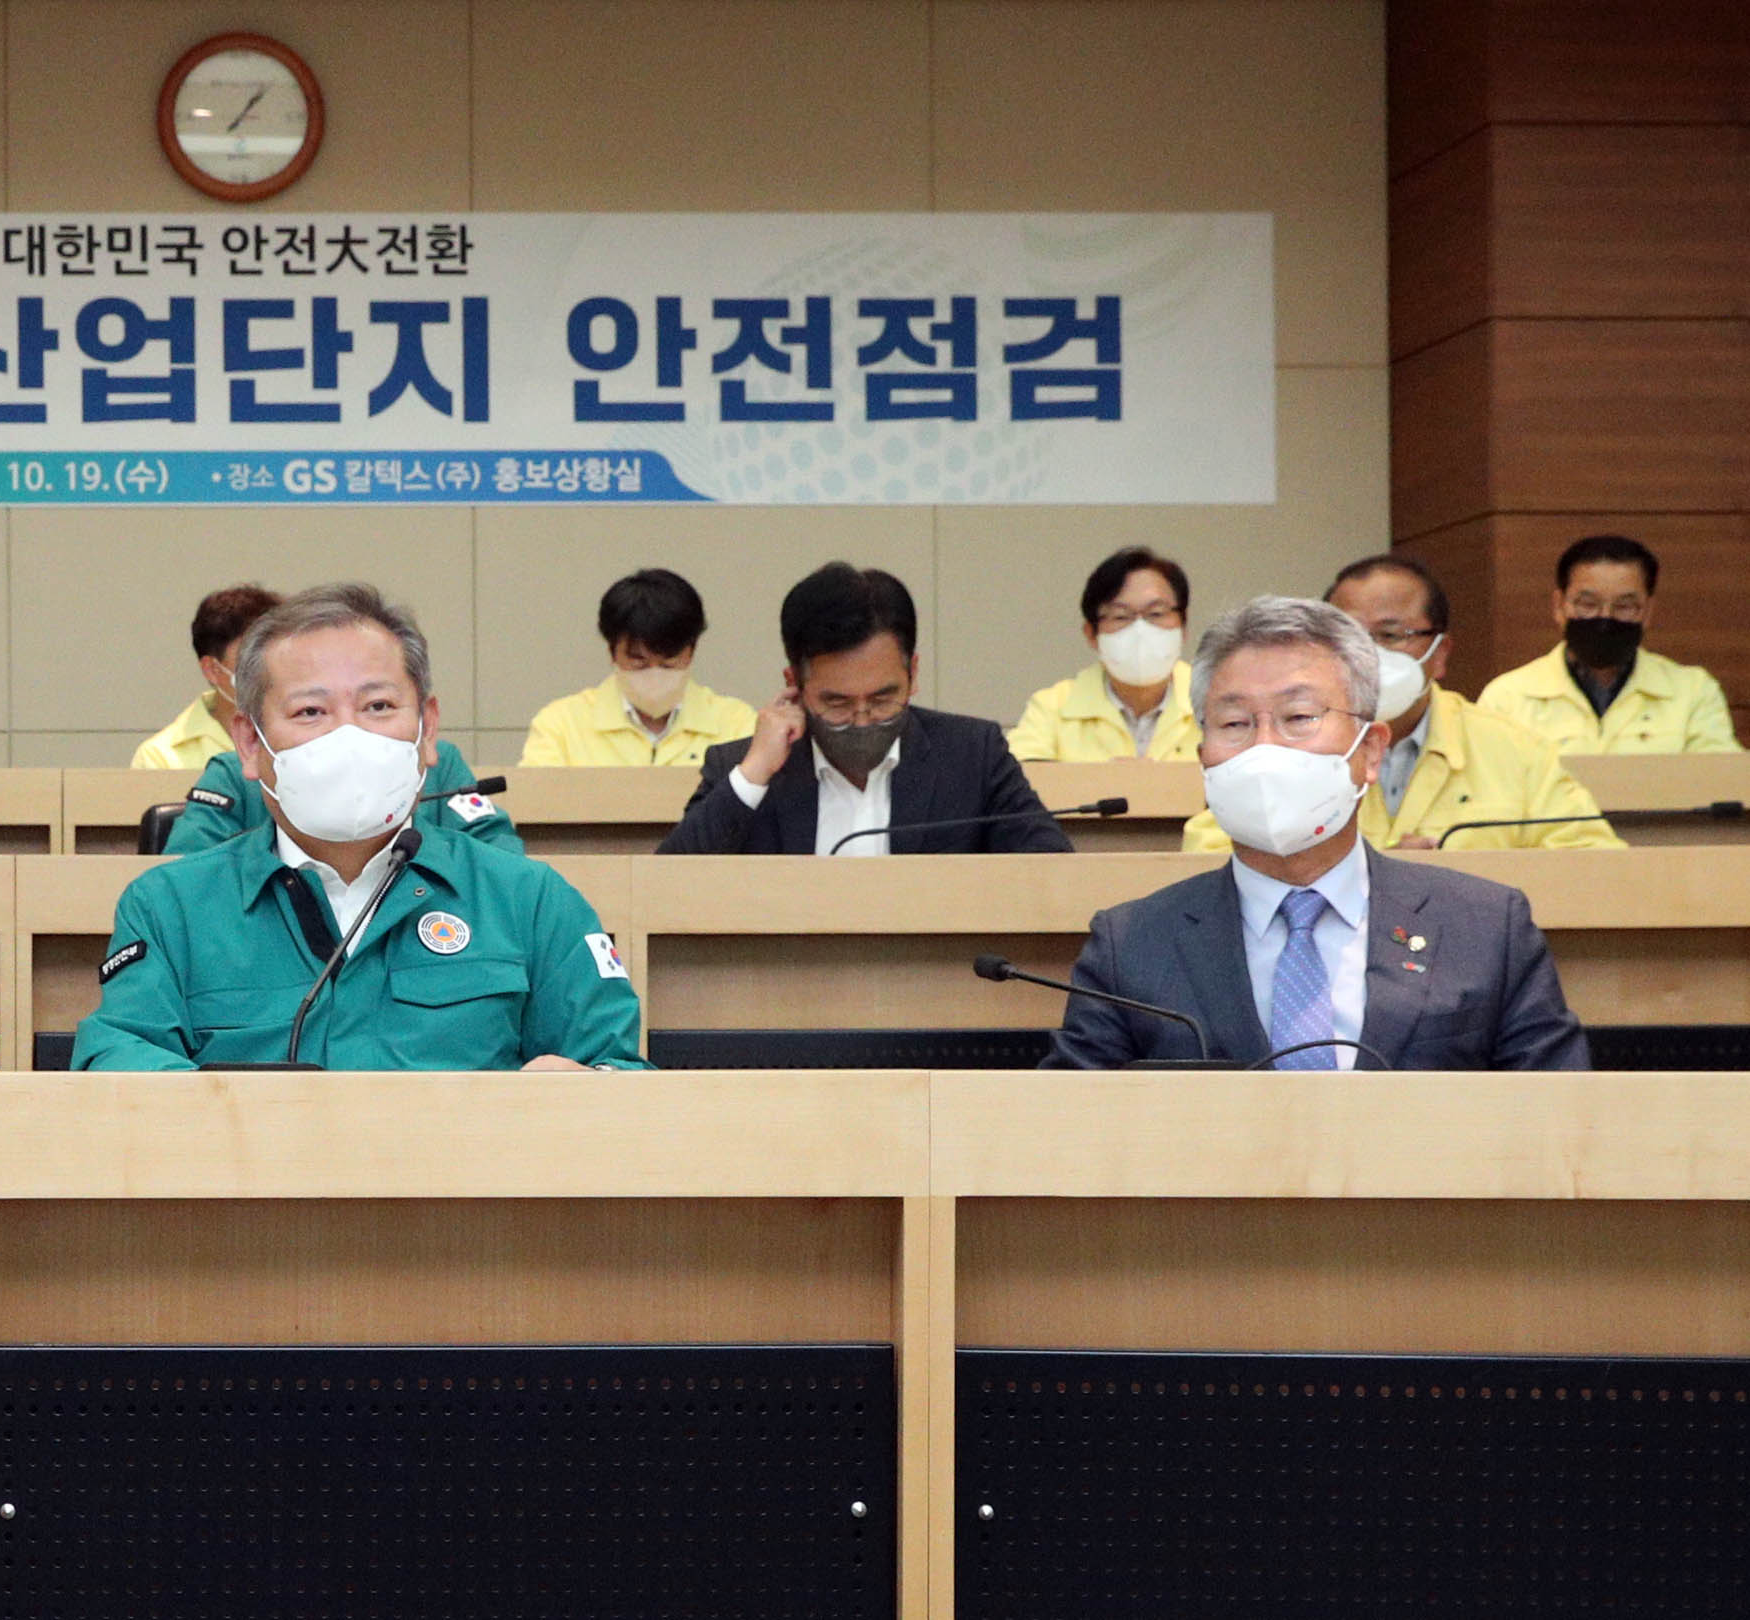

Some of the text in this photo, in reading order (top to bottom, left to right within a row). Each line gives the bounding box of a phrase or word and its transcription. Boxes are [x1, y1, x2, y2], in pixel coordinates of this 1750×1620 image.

[3, 223, 475, 277] 대한민국 안전大전환
[566, 296, 1123, 424] 안전점검
[8, 462, 54, 492] 10.
[283, 460, 338, 494] GS
[493, 458, 642, 494] 홍보상황실
